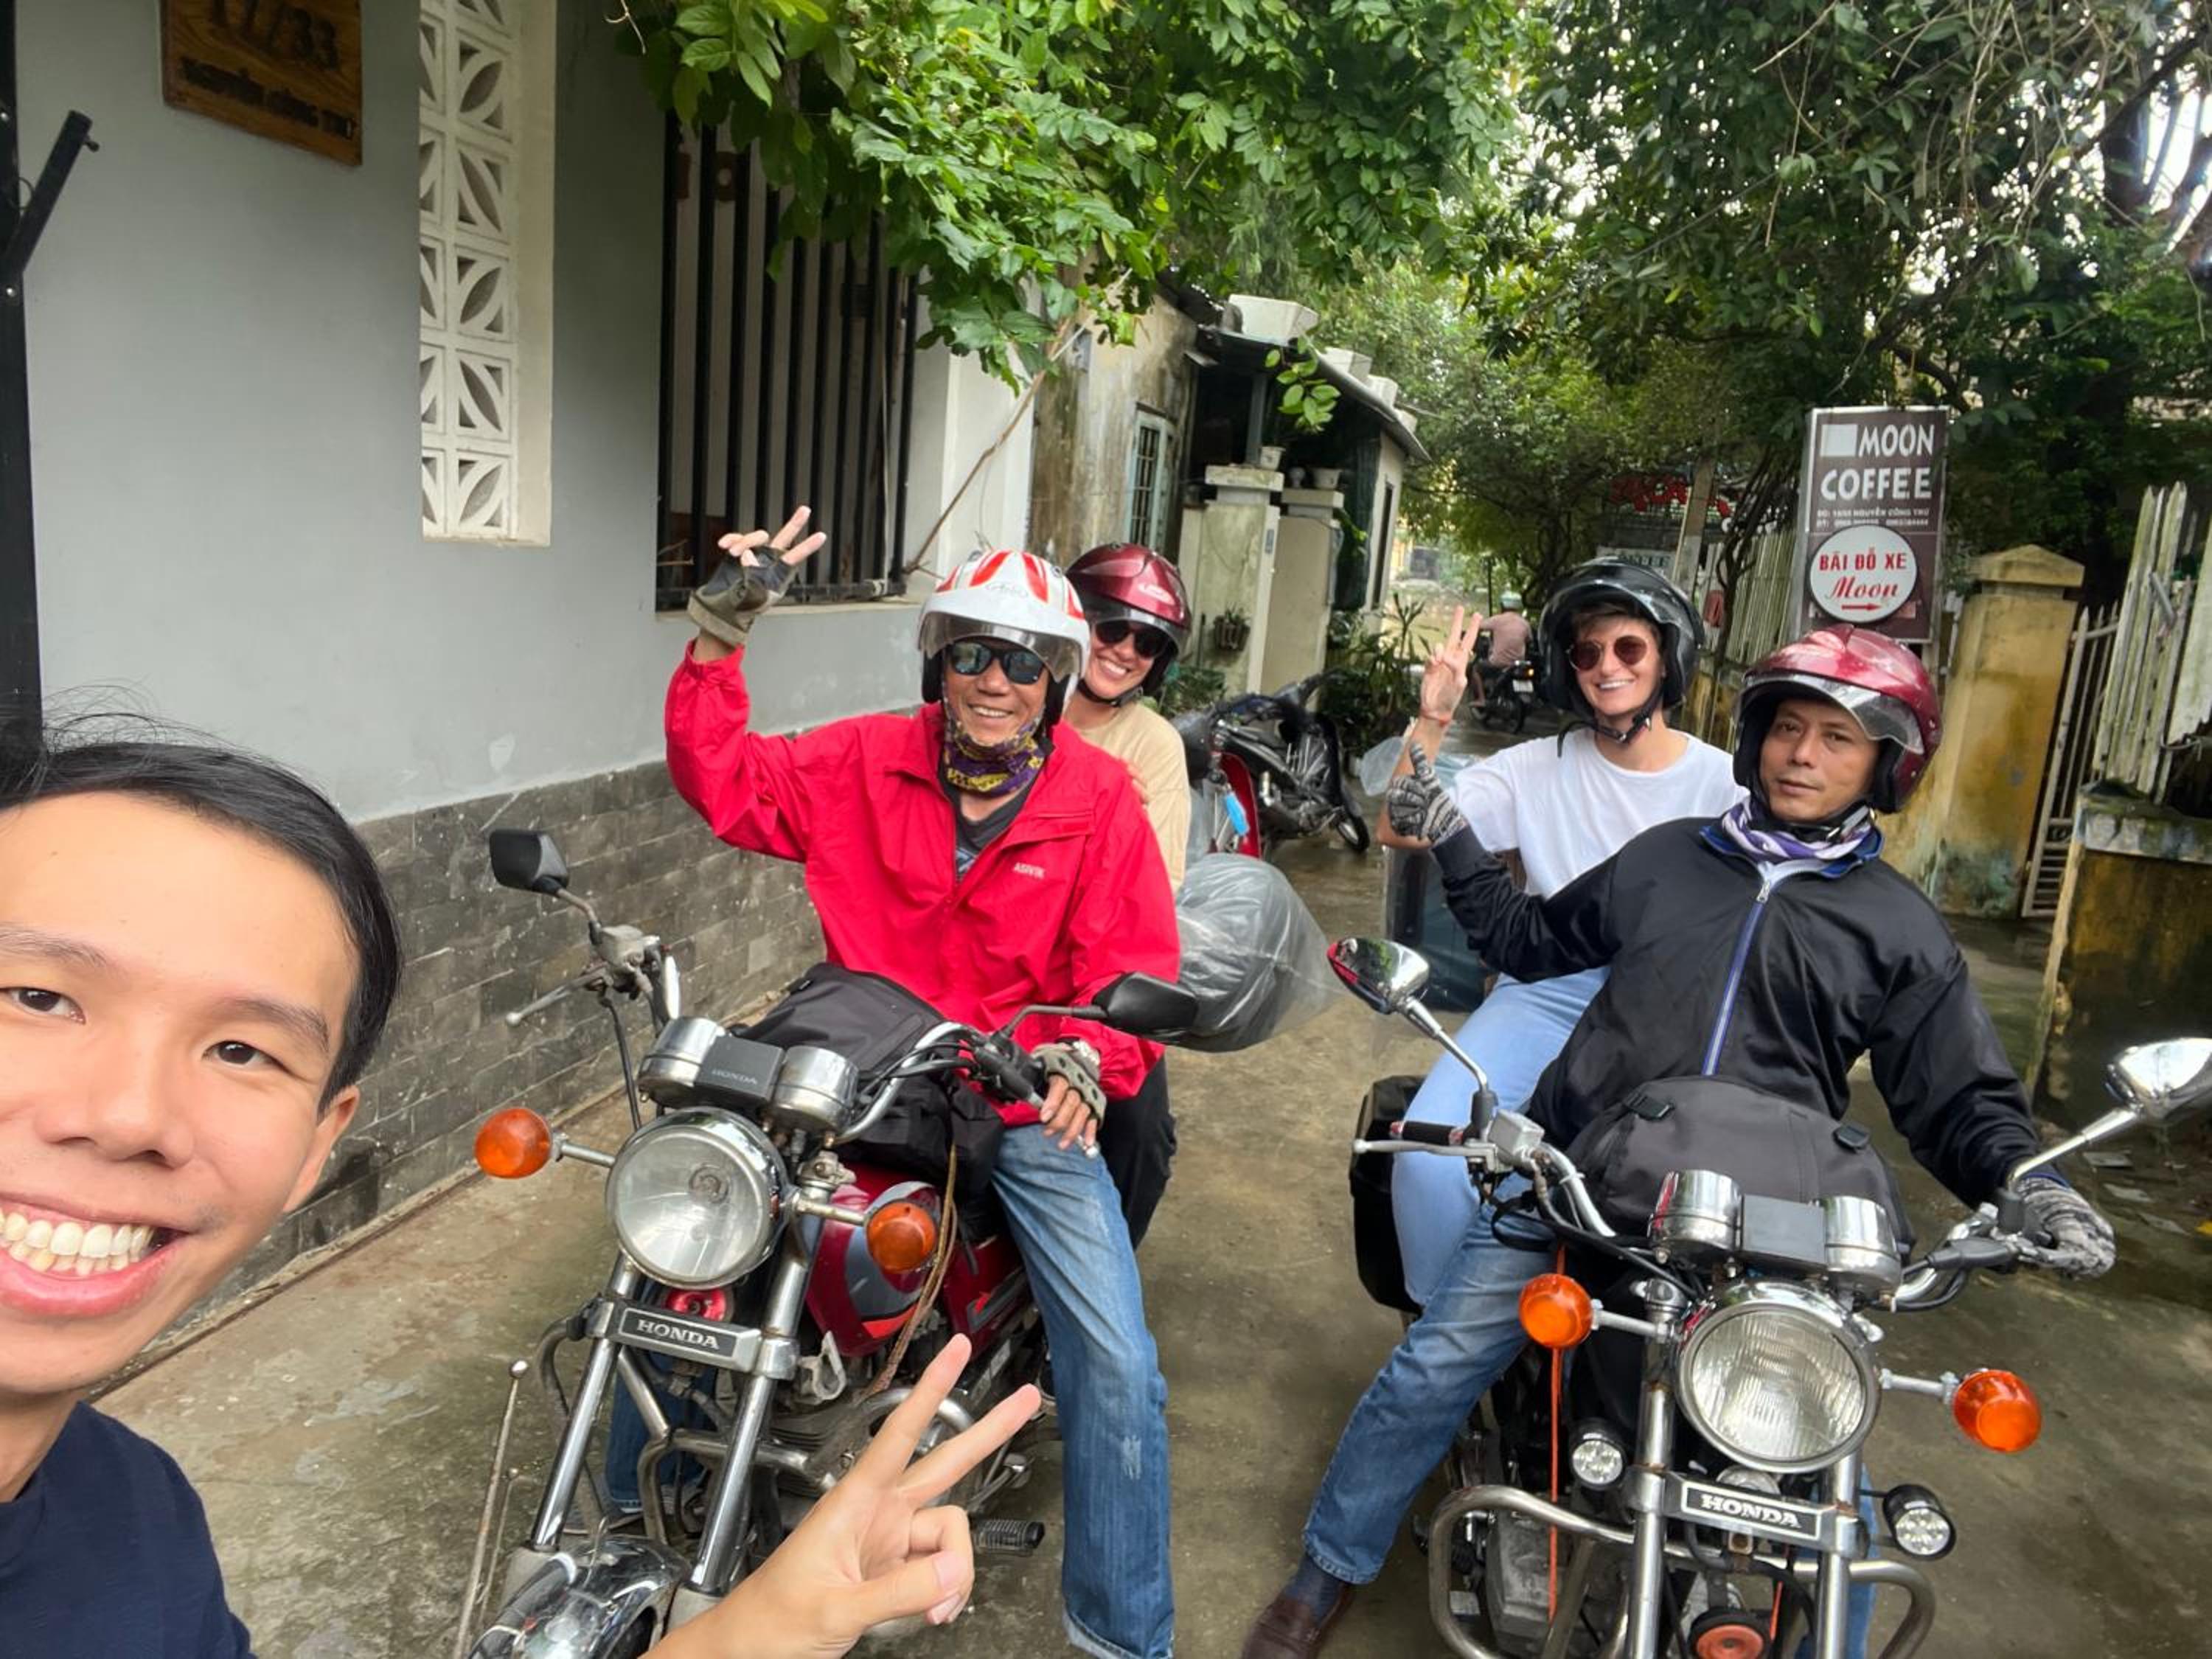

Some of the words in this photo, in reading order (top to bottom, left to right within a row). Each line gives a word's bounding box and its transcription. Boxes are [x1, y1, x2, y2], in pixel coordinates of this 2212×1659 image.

[1858, 424, 1935, 458] MOON
[1820, 467, 1932, 501] COFFEE
[1819, 551, 1848, 571] BÃI
[1854, 546, 1877, 571] ĐỖ
[1885, 552, 1907, 569] XE
[1825, 576, 1899, 599] Moon
[712, 1068, 758, 1085] HONDA
[637, 1319, 720, 1350] HONDA
[1700, 1494, 1802, 1529] HONDA
